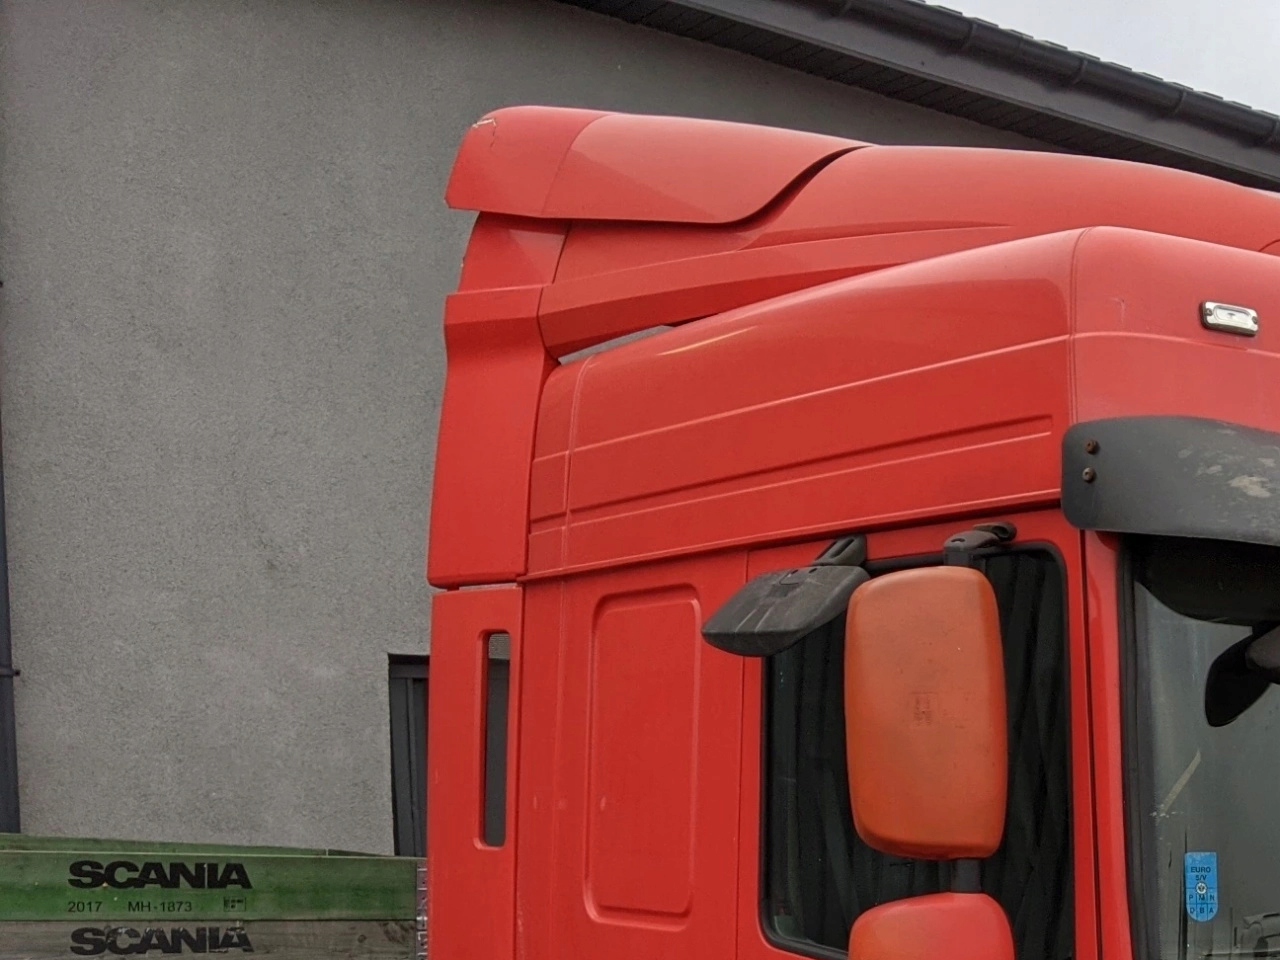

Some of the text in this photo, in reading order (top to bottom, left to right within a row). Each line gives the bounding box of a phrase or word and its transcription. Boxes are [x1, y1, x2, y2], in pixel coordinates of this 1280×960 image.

[67, 860, 253, 889] SCANIA
[67, 901, 103, 913] 2017
[69, 926, 255, 956] SCANIA
